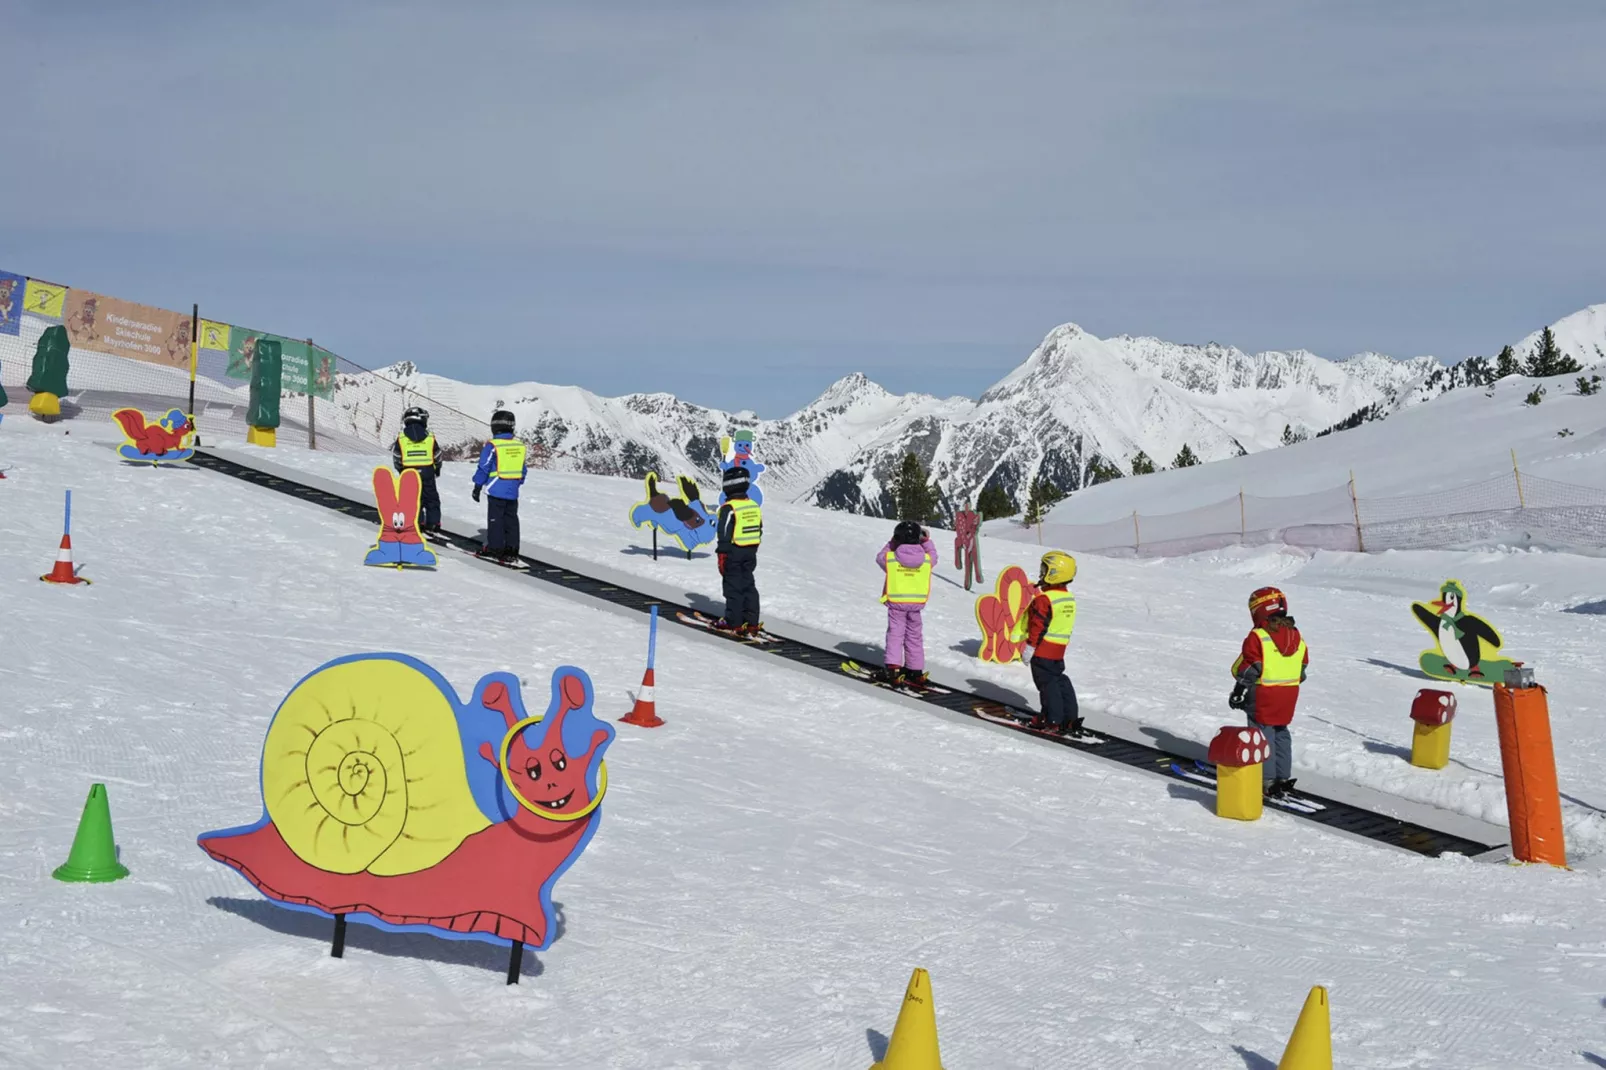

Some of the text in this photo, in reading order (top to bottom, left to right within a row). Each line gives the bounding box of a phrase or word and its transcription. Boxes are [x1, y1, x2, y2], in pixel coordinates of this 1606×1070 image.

[106, 313, 162, 333] Kinderparadies
[115, 327, 152, 342] Skischule
[103, 335, 161, 355] Mayrhofen 3000
